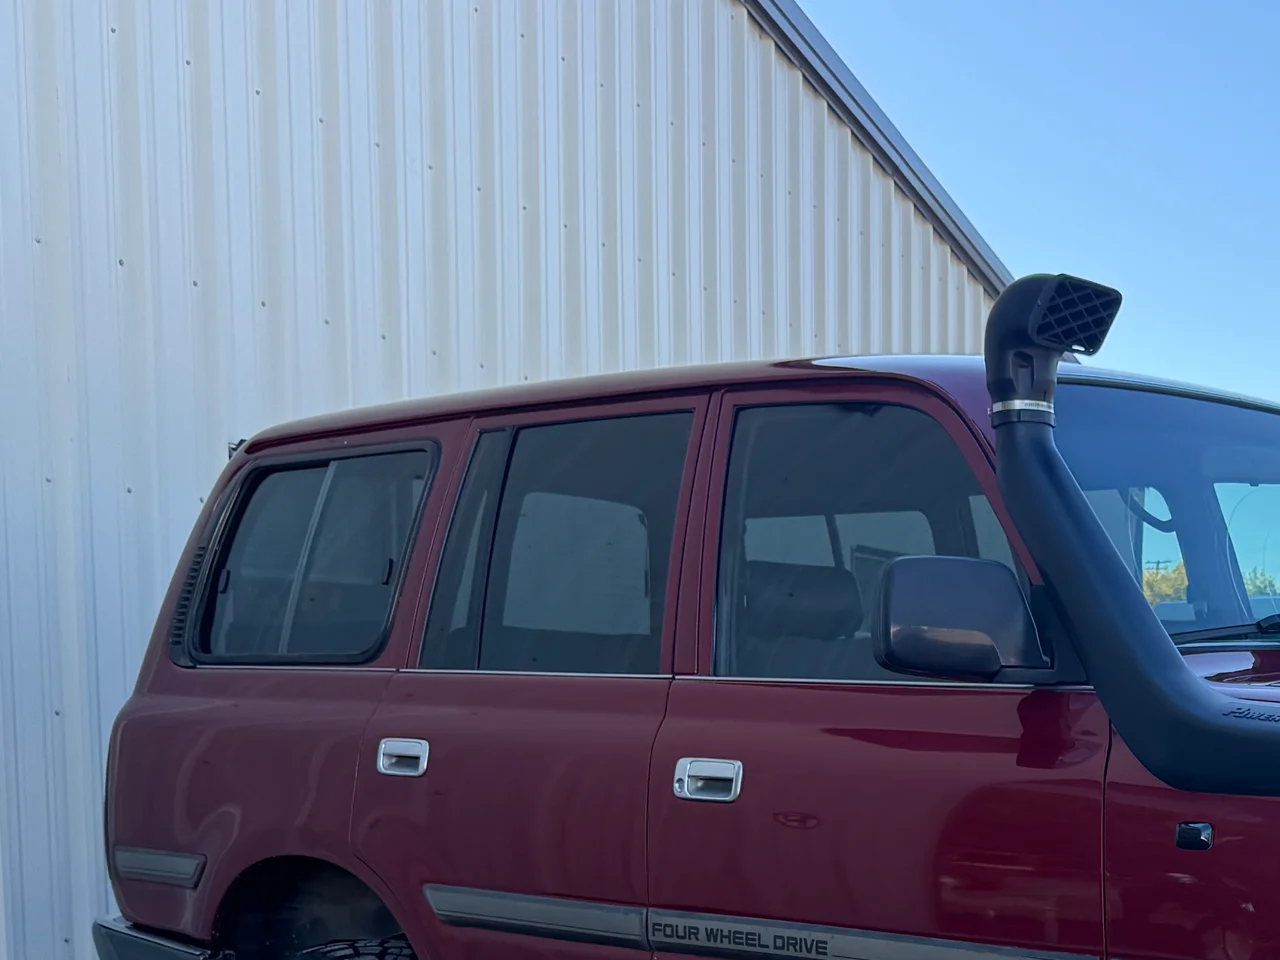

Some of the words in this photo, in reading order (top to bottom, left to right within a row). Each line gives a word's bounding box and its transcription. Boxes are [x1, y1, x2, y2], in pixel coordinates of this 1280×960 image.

[652, 923, 700, 941] FOUR
[705, 928, 769, 949] WHEEL
[773, 935, 828, 956] DRIVE
